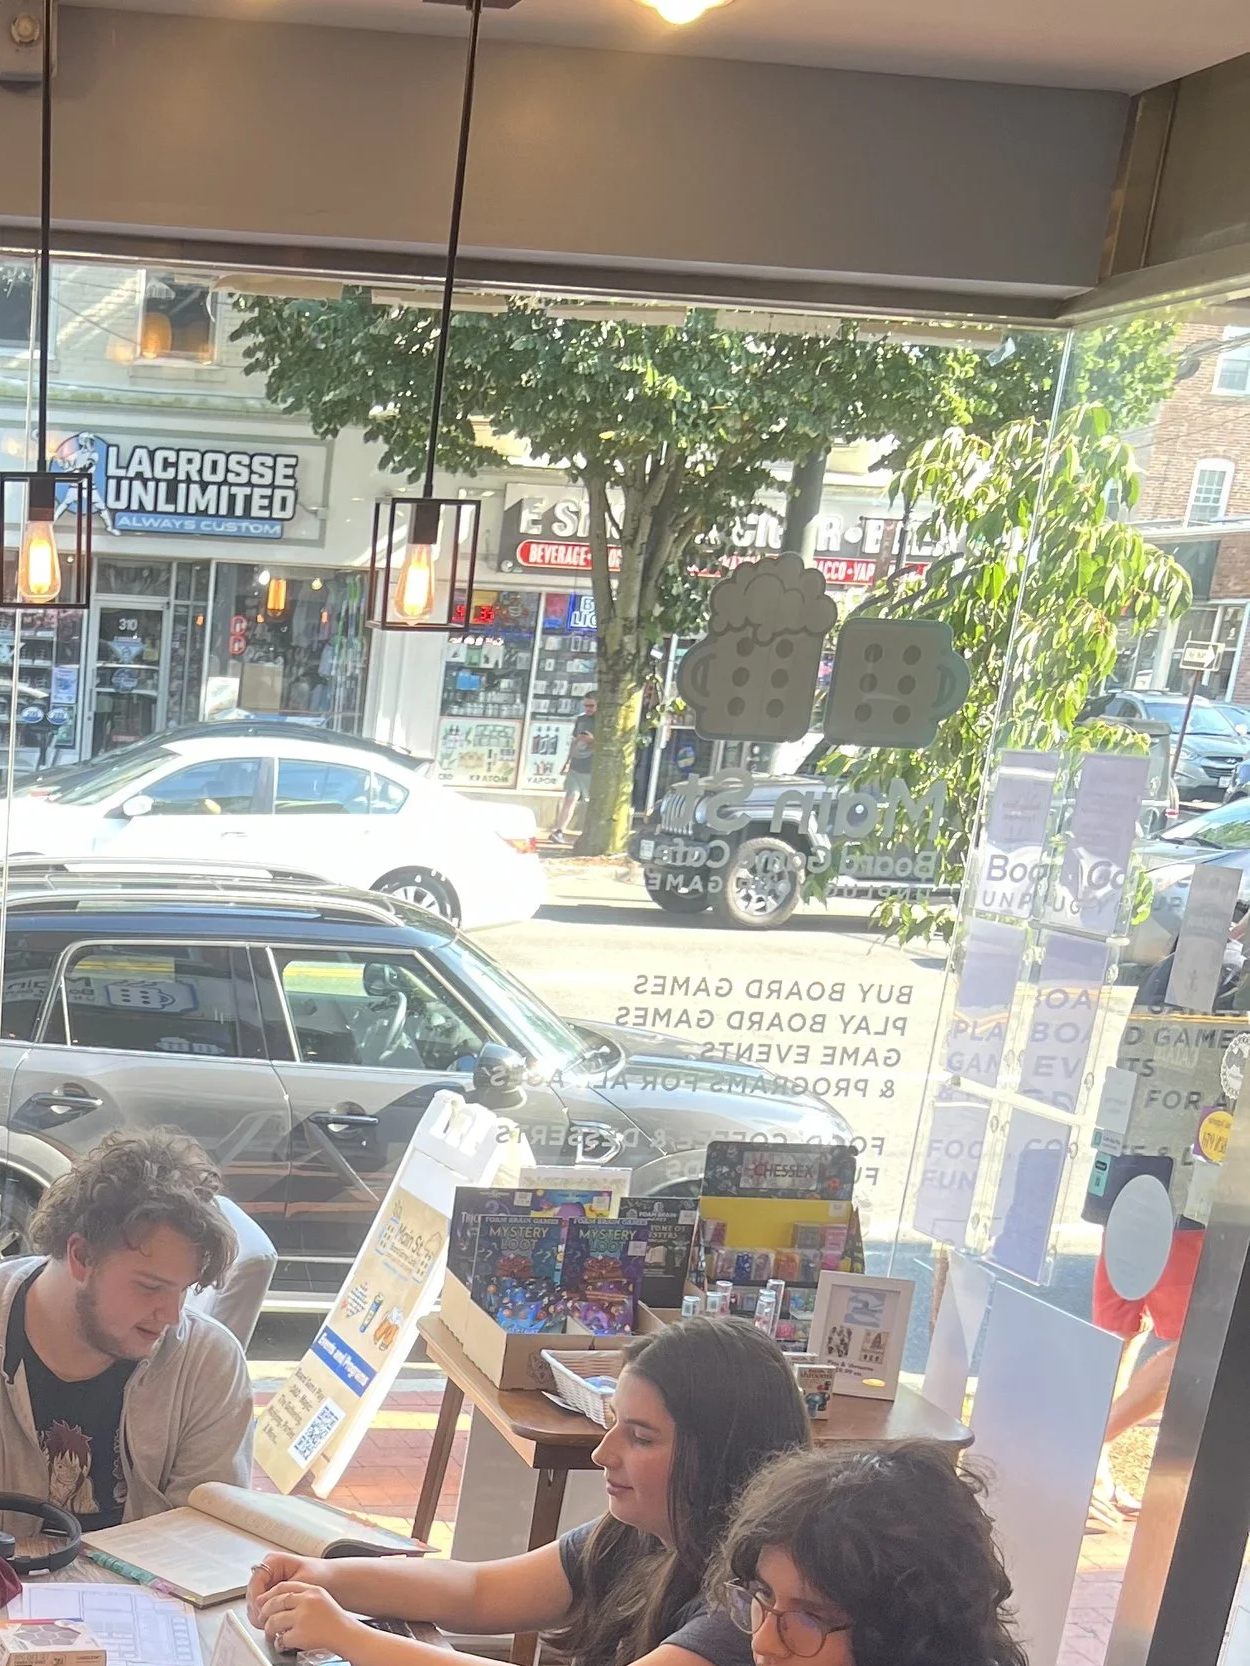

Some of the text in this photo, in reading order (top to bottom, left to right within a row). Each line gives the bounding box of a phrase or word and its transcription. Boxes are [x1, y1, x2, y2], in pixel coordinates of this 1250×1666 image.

[107, 445, 297, 487] LACROSSE
[107, 478, 297, 520] UNLIMITED
[117, 515, 282, 536] ALWAYS CUSTOM
[529, 543, 587, 567] BEVERAGE
[118, 617, 138, 632] 310
[469, 774, 510, 783] KRATOM
[1144, 1089, 1207, 1110] FOR
[753, 1162, 814, 1179] CHESSEX
[485, 1216, 560, 1226] FOAM BRAIN GAMES
[489, 1226, 549, 1239] MYSTERY
[579, 1229, 637, 1241] MYSTERY
[501, 1237, 539, 1251] LOOT
[588, 1240, 626, 1253] LOOT
[316, 1331, 371, 1388] Events and Programs
